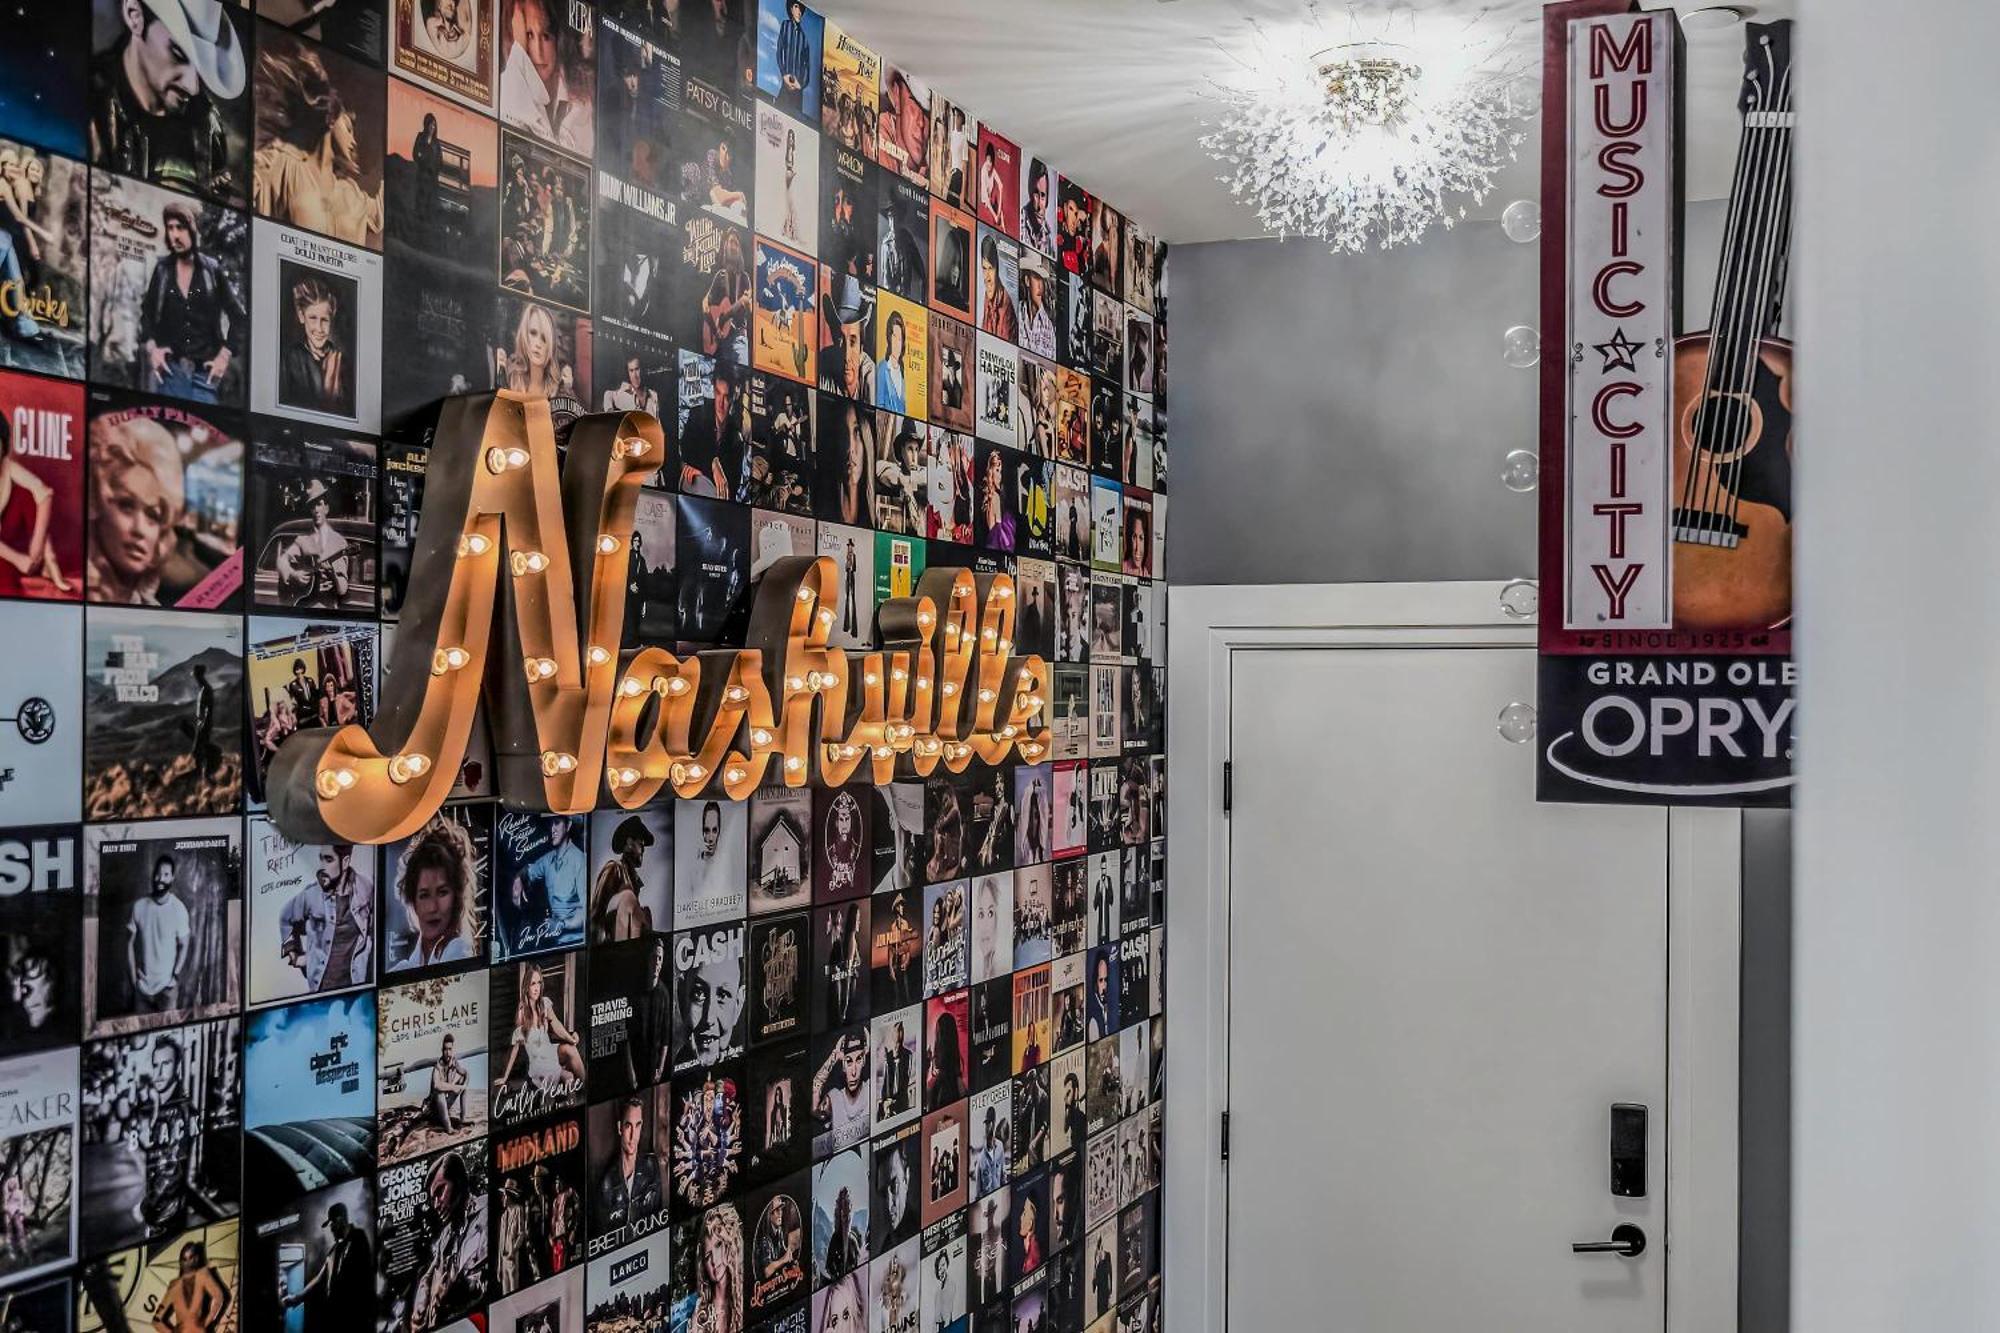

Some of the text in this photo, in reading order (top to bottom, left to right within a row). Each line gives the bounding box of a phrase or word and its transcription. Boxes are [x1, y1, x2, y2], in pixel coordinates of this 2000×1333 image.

[686, 80, 720, 113] PATSY
[722, 101, 752, 130] CLINE
[1588, 18, 1653, 318] MUSIC
[979, 362, 1016, 385] HARRIS
[13, 405, 73, 461] CLINE
[1057, 467, 1089, 493] CASH
[1590, 381, 1645, 619] CITY
[266, 388, 1054, 847] Nashville
[1602, 632, 1745, 648] SINCE 1925
[1587, 661, 1799, 685] GRAND OLE
[1581, 695, 1797, 758] OPRY
[675, 927, 744, 972] CASH
[1120, 933, 1150, 962] CASH
[391, 1001, 479, 1033] CHRIS LANE
[591, 997, 628, 1015] TRAVIS
[591, 1006, 633, 1027] DENNING
[128, 1115, 201, 1151] BLACK
[496, 1120, 581, 1174] MIDLAND
[380, 1160, 428, 1188] GEORGE
[384, 1178, 422, 1203] JONES
[378, 1202, 397, 1218] THE
[588, 1208, 669, 1257] BRETT YOUNG
[612, 1256, 646, 1281] LANCO
